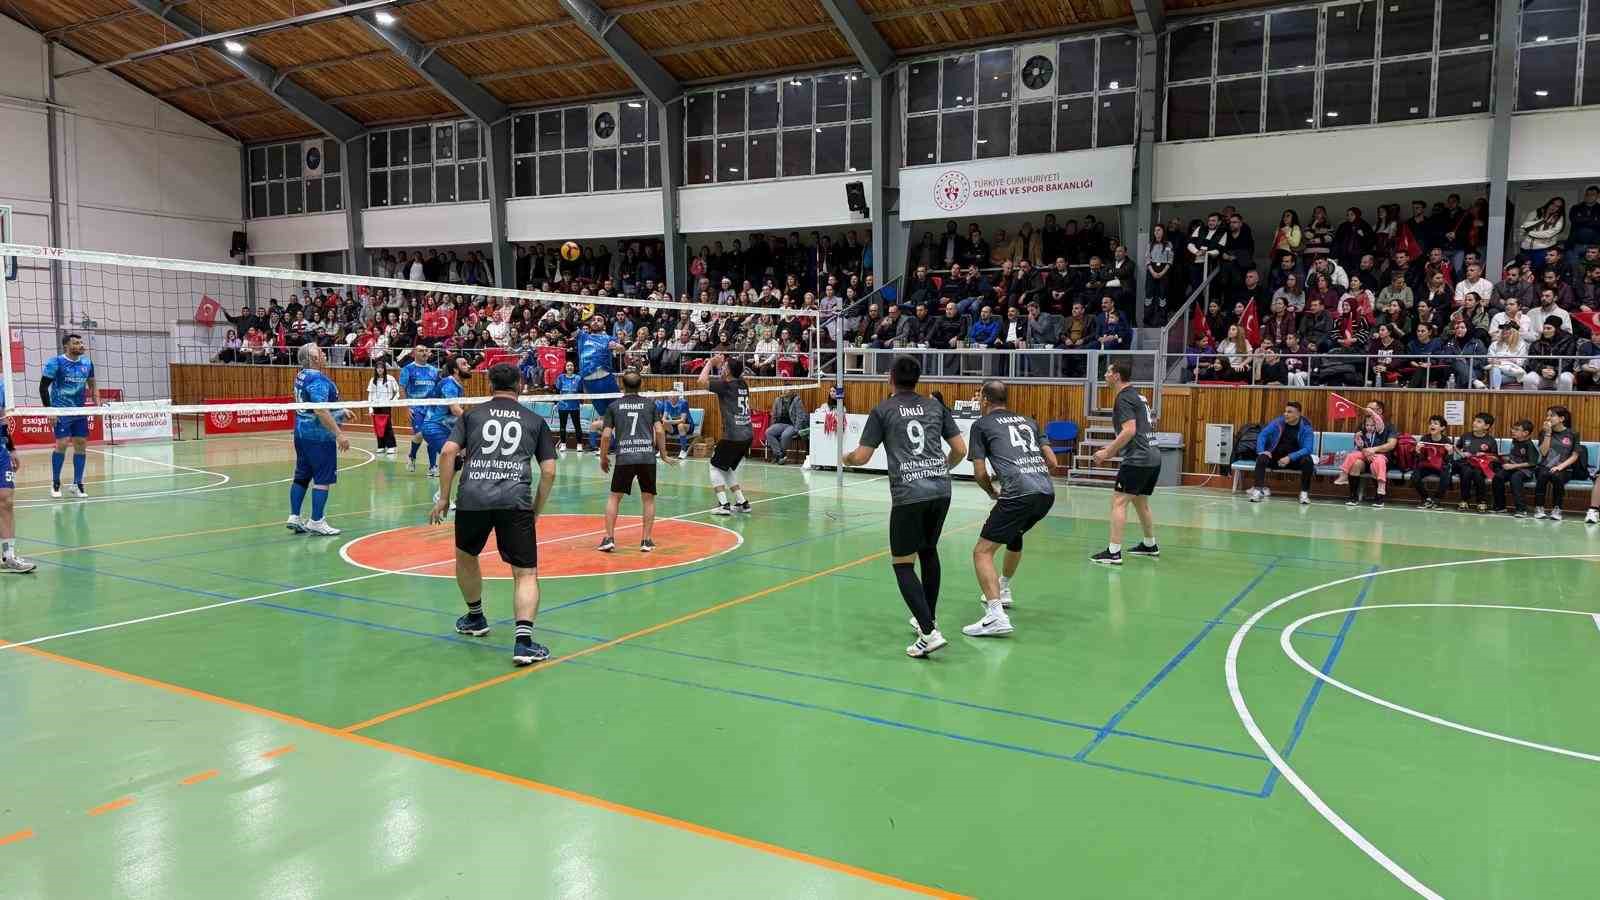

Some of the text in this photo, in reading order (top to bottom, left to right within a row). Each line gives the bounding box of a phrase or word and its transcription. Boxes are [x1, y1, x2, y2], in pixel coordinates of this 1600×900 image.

[973, 178, 1093, 198] GENÇLİK VE SPOR BAKANLIĞI
[974, 172, 1060, 187] TÜRKİYE CUMHURİYETİ
[489, 409, 521, 419] VURAL
[899, 405, 924, 416] ÜNLÜ
[627, 412, 639, 436] 7
[995, 415, 1027, 424] HAKAN
[481, 419, 522, 456] 99
[906, 420, 925, 456] 9
[1008, 424, 1040, 453] 42
[470, 460, 523, 471] HAVA MEYDAN
